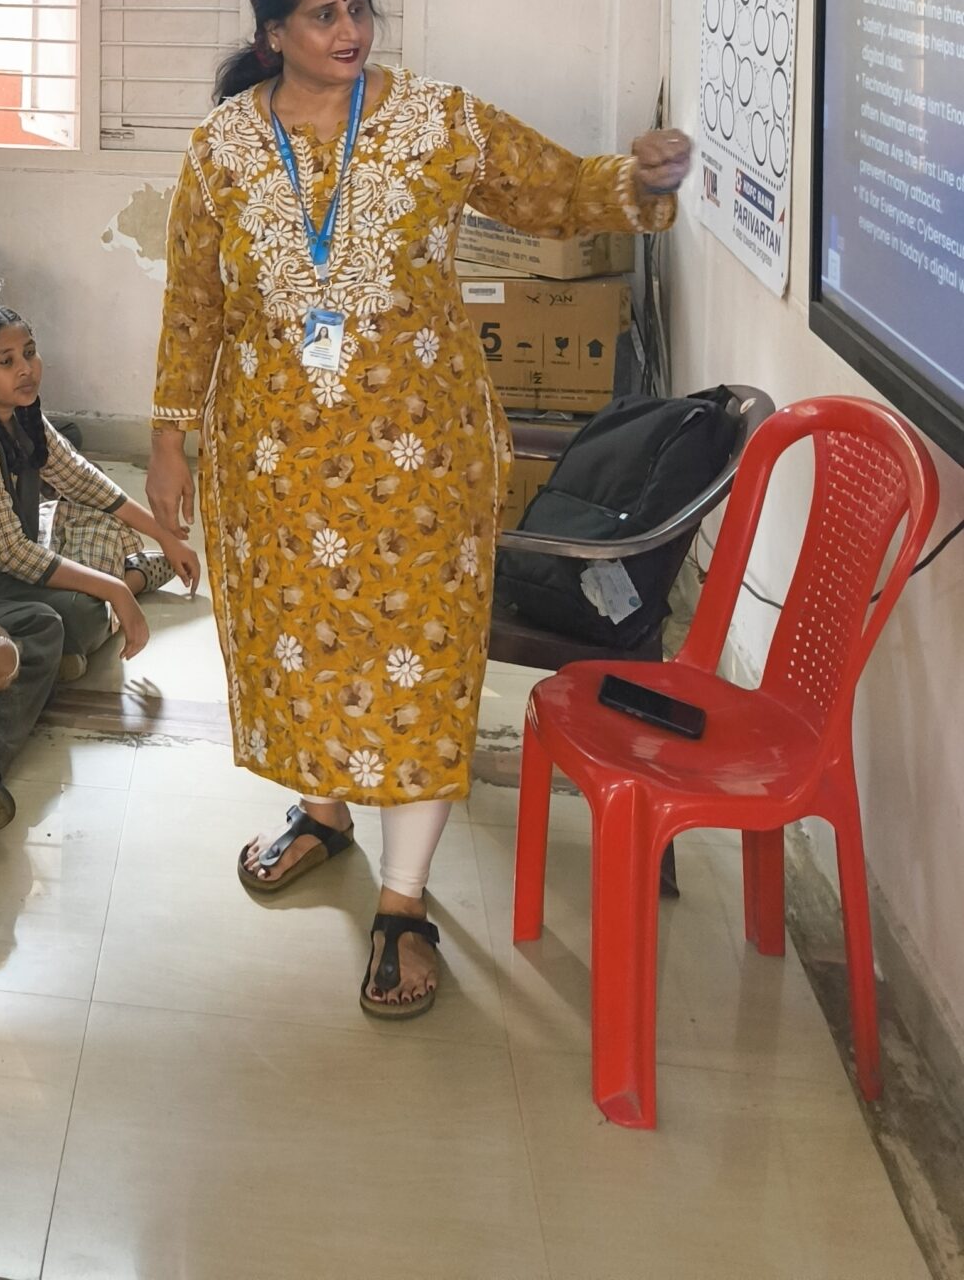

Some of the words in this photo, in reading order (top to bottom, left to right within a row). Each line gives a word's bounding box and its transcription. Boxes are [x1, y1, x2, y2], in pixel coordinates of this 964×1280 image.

[917, 0, 942, 20] online
[861, 44, 885, 68] digital
[887, 23, 930, 50] Awareness
[930, 32, 955, 60] helps
[861, 72, 903, 107] Technology
[904, 88, 926, 111] Alone
[860, 101, 879, 122] often
[879, 108, 907, 135] human
[907, 123, 929, 144] error.
[859, 128, 889, 156] Humans
[890, 143, 904, 162] Are
[904, 149, 918, 170] the
[918, 155, 936, 179] First
[937, 163, 955, 187] Line
[742, 178, 757, 201] HDFC
[757, 190, 773, 214] BANK
[859, 159, 886, 184] prevent
[887, 173, 909, 200] many
[910, 185, 943, 214] attacks.
[869, 189, 880, 209] for
[733, 199, 781, 256] PARIVARTAN
[858, 215, 890, 245] everyone
[890, 230, 898, 251] in
[899, 238, 929, 271] today's
[929, 257, 957, 288] digital
[480, 322, 502, 354] 5
